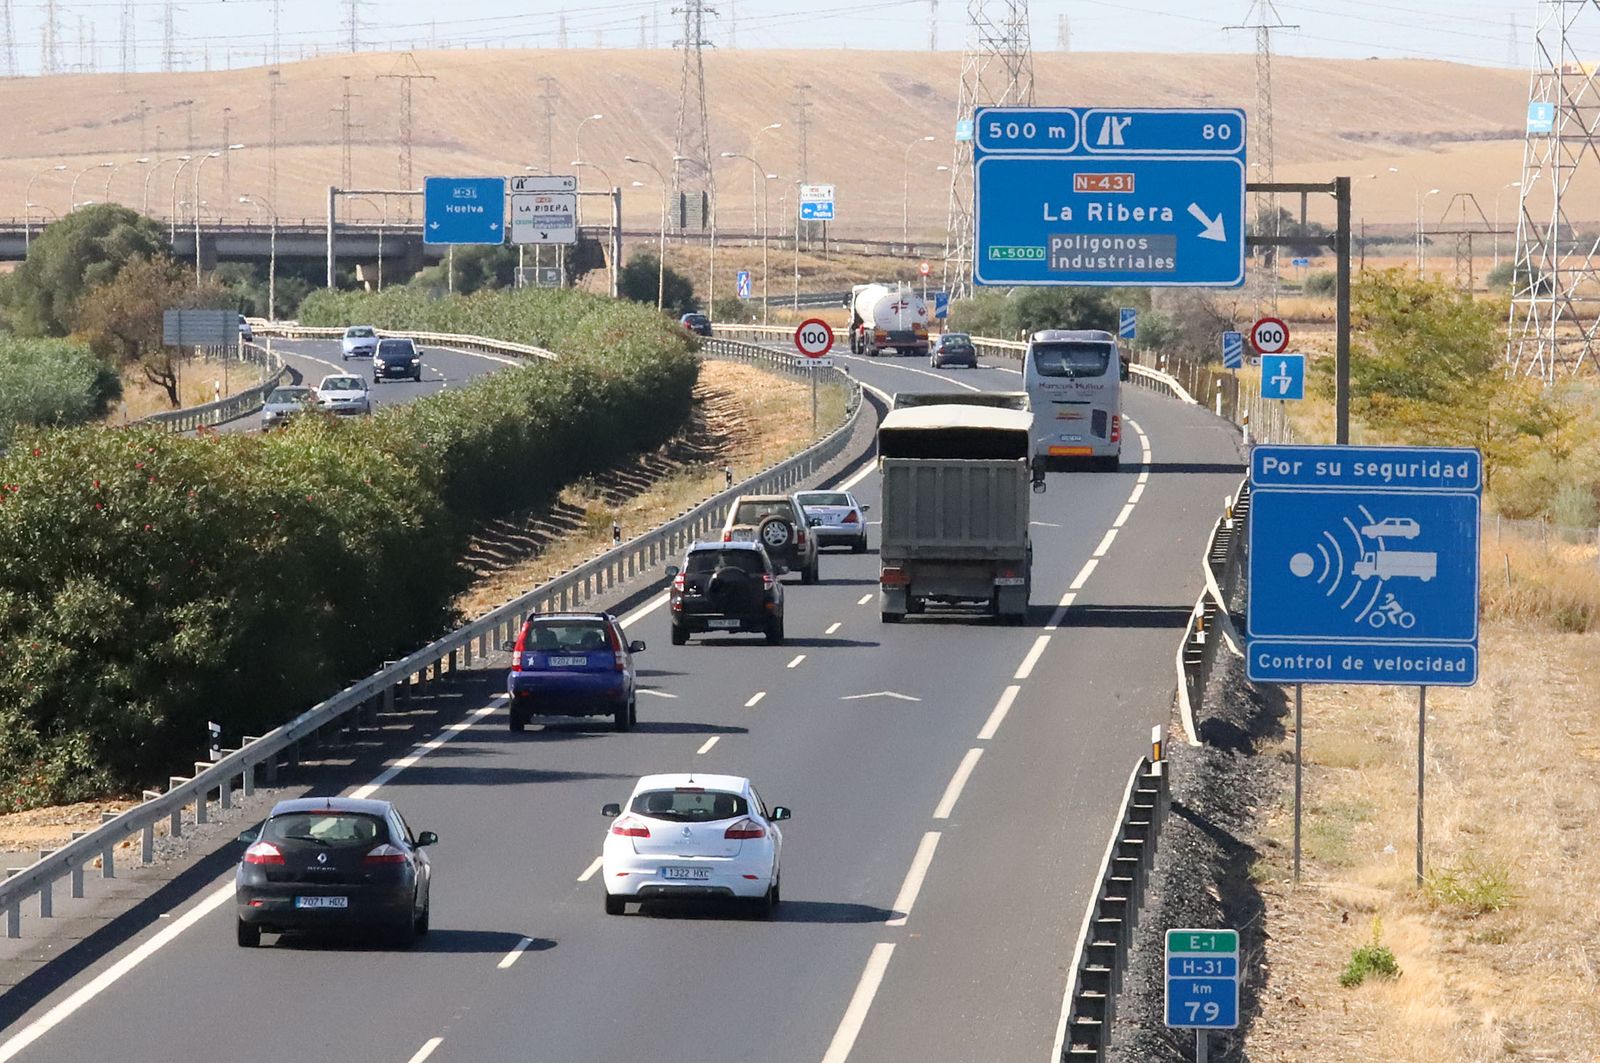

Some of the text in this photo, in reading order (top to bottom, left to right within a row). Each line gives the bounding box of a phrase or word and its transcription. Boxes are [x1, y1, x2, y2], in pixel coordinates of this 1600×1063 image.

[989, 122, 1066, 139] 500 m
[1202, 124, 1231, 140] 80
[1076, 175, 1133, 191] N-431
[446, 204, 484, 213] Huelva
[1043, 202, 1174, 222] La Ribera
[991, 247, 1044, 259] A-5000
[1051, 254, 1175, 269] industriales
[802, 331, 826, 344] 100
[1258, 330, 1282, 344] 100
[1262, 456, 1469, 483] Por su seguridad
[1258, 653, 1466, 672] Control de velocidad
[670, 868, 709, 878] 1322 HXC
[303, 897, 324, 906] 7071
[1190, 935, 1215, 950] E-1
[1183, 960, 1222, 974] H-31
[1192, 983, 1212, 994] km
[1184, 1001, 1220, 1022] 79
